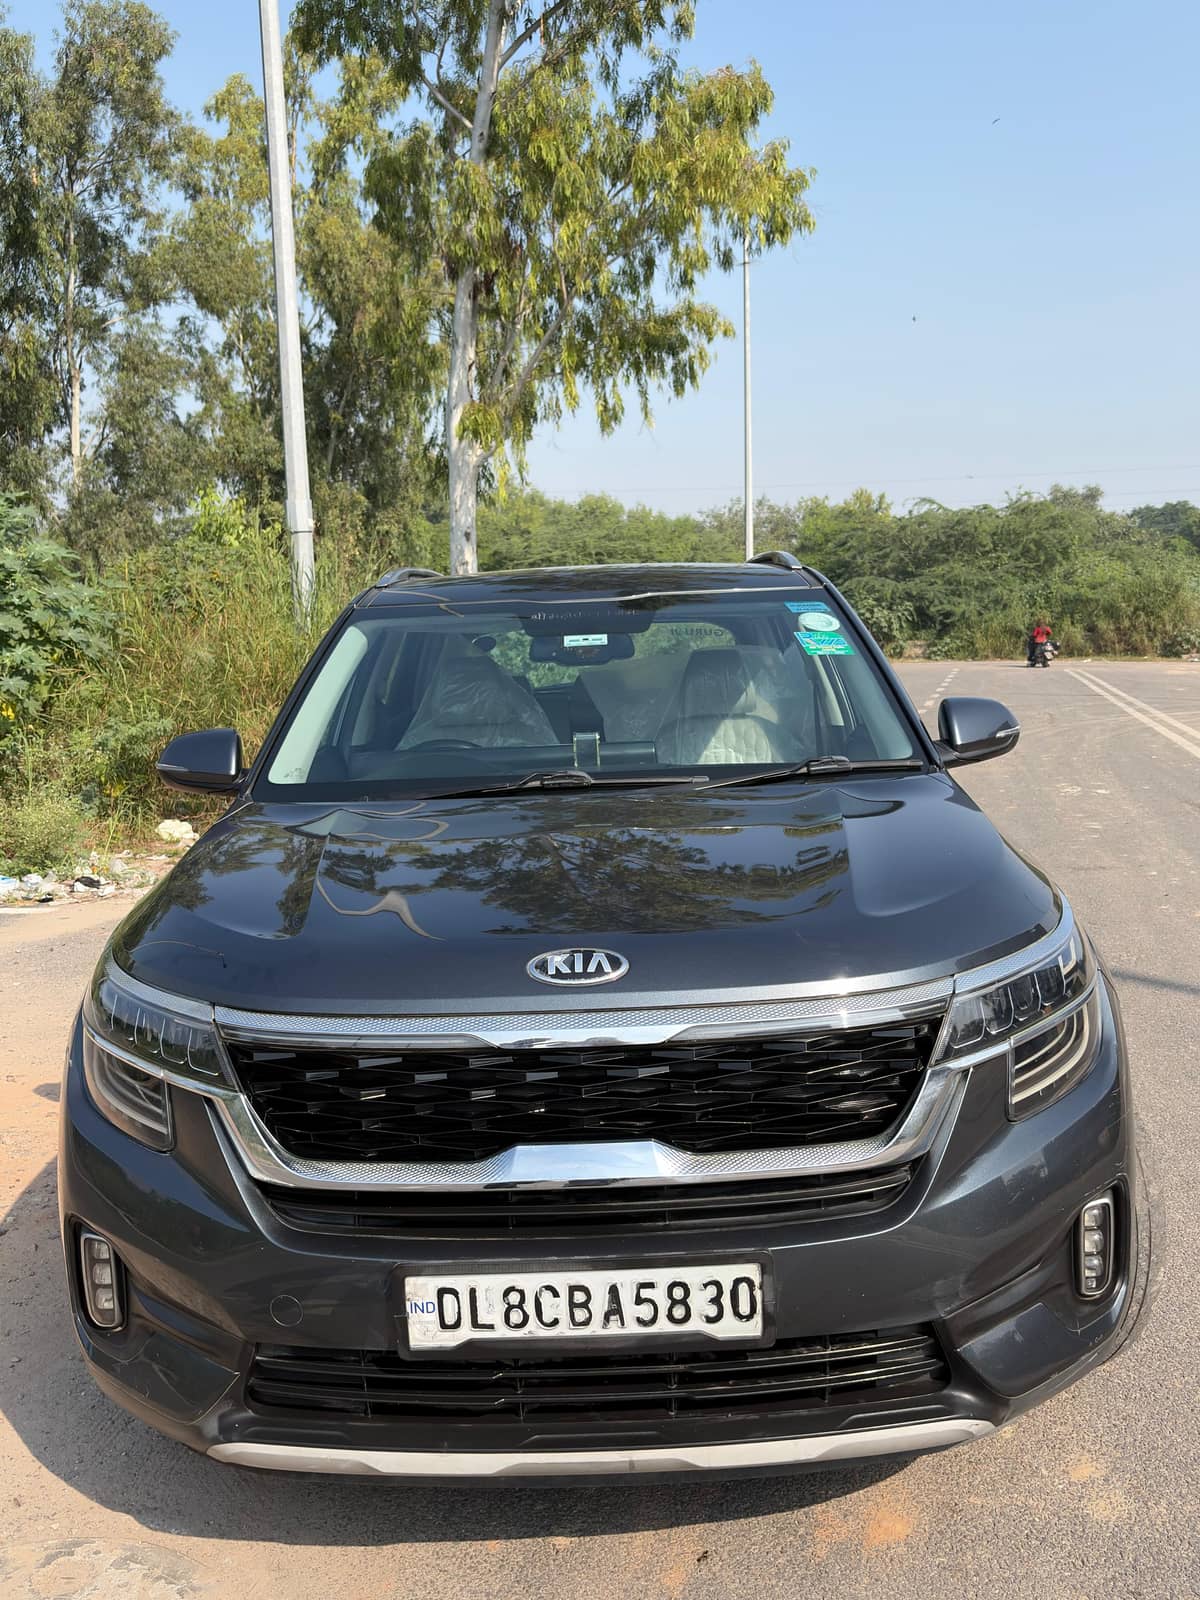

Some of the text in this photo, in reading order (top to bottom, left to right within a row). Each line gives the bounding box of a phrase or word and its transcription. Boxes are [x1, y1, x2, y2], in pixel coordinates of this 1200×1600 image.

[546, 952, 613, 975] KIA
[409, 1276, 757, 1330] IND DL8CBA5830
